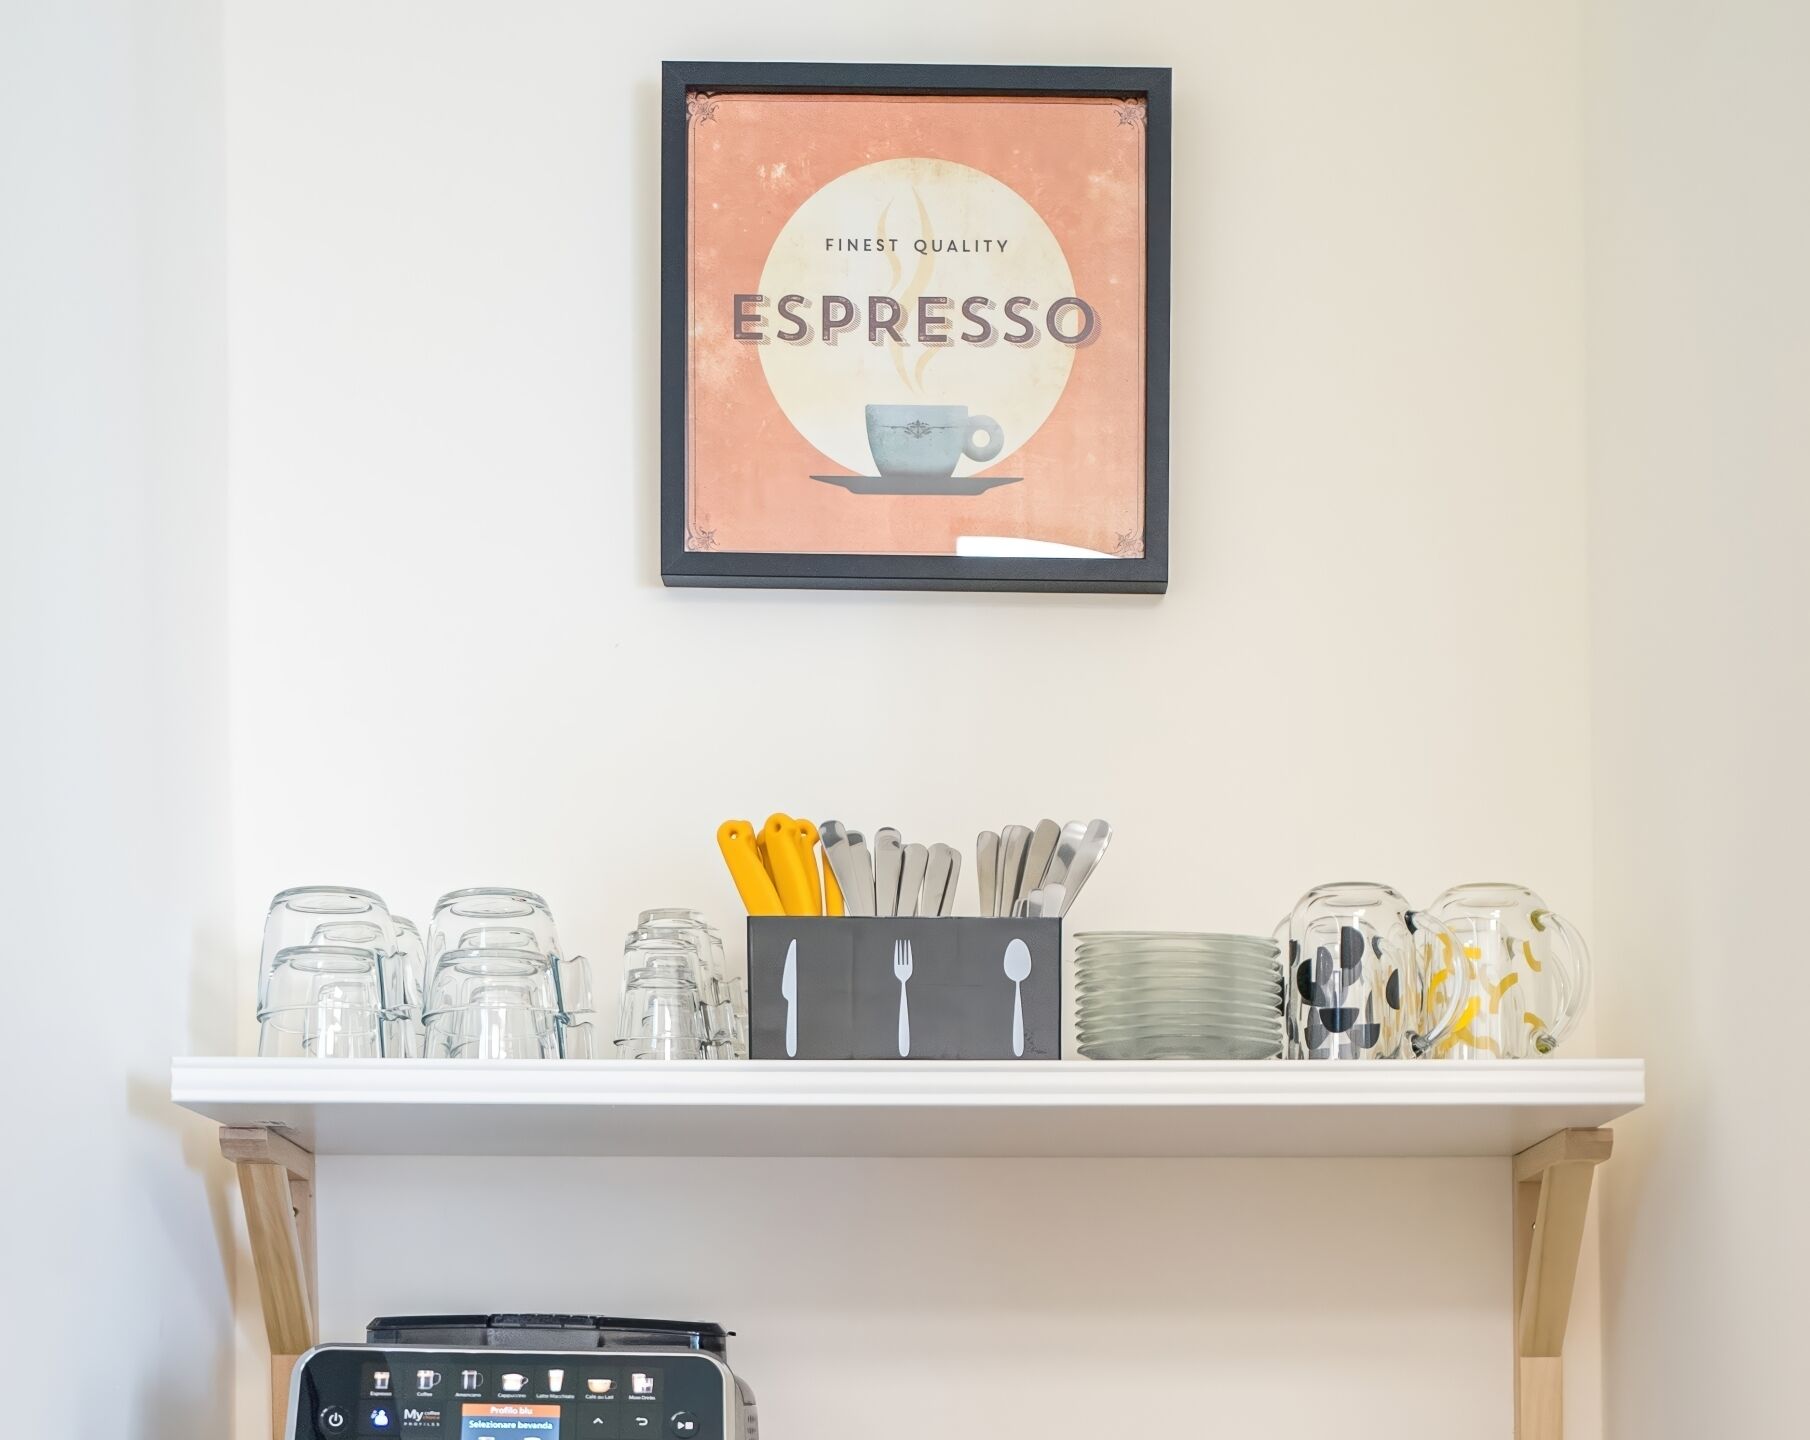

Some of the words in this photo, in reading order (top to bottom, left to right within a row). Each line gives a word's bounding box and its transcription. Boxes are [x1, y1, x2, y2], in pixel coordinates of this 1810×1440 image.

[825, 238, 899, 253] FINEST
[914, 239, 1009, 255] QUALITY
[732, 293, 1102, 350] ESPRESSO
[403, 1408, 424, 1422] My
[490, 1406, 518, 1415] Profilo
[519, 1407, 533, 1415] blu
[468, 1419, 516, 1429] Selezionare
[517, 1420, 553, 1430] bevanda
